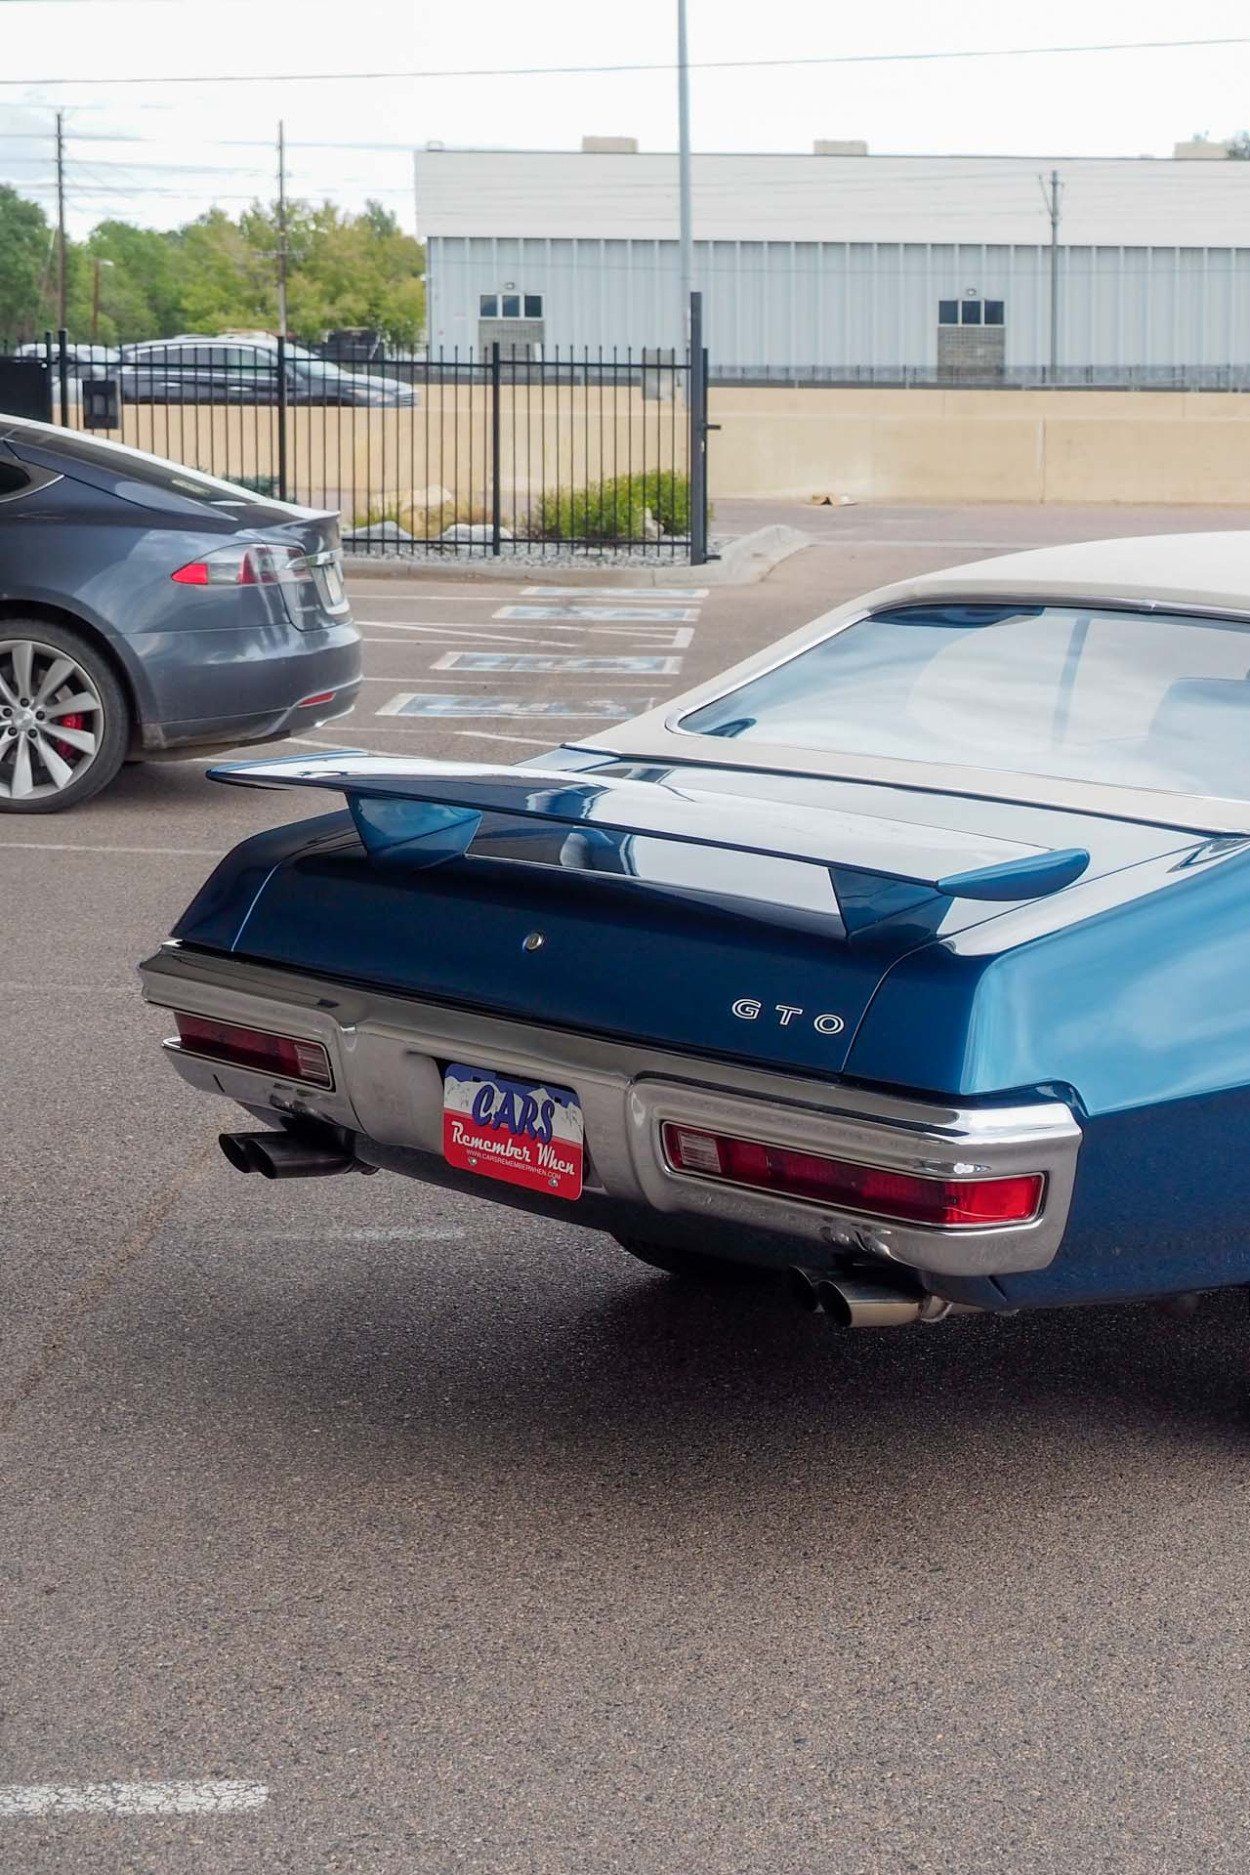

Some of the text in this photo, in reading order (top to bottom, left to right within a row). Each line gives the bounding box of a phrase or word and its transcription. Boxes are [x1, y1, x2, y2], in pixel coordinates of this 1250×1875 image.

[731, 998, 845, 1035] GTO
[472, 1085, 555, 1144] CARS
[451, 1121, 575, 1175] Remember When
